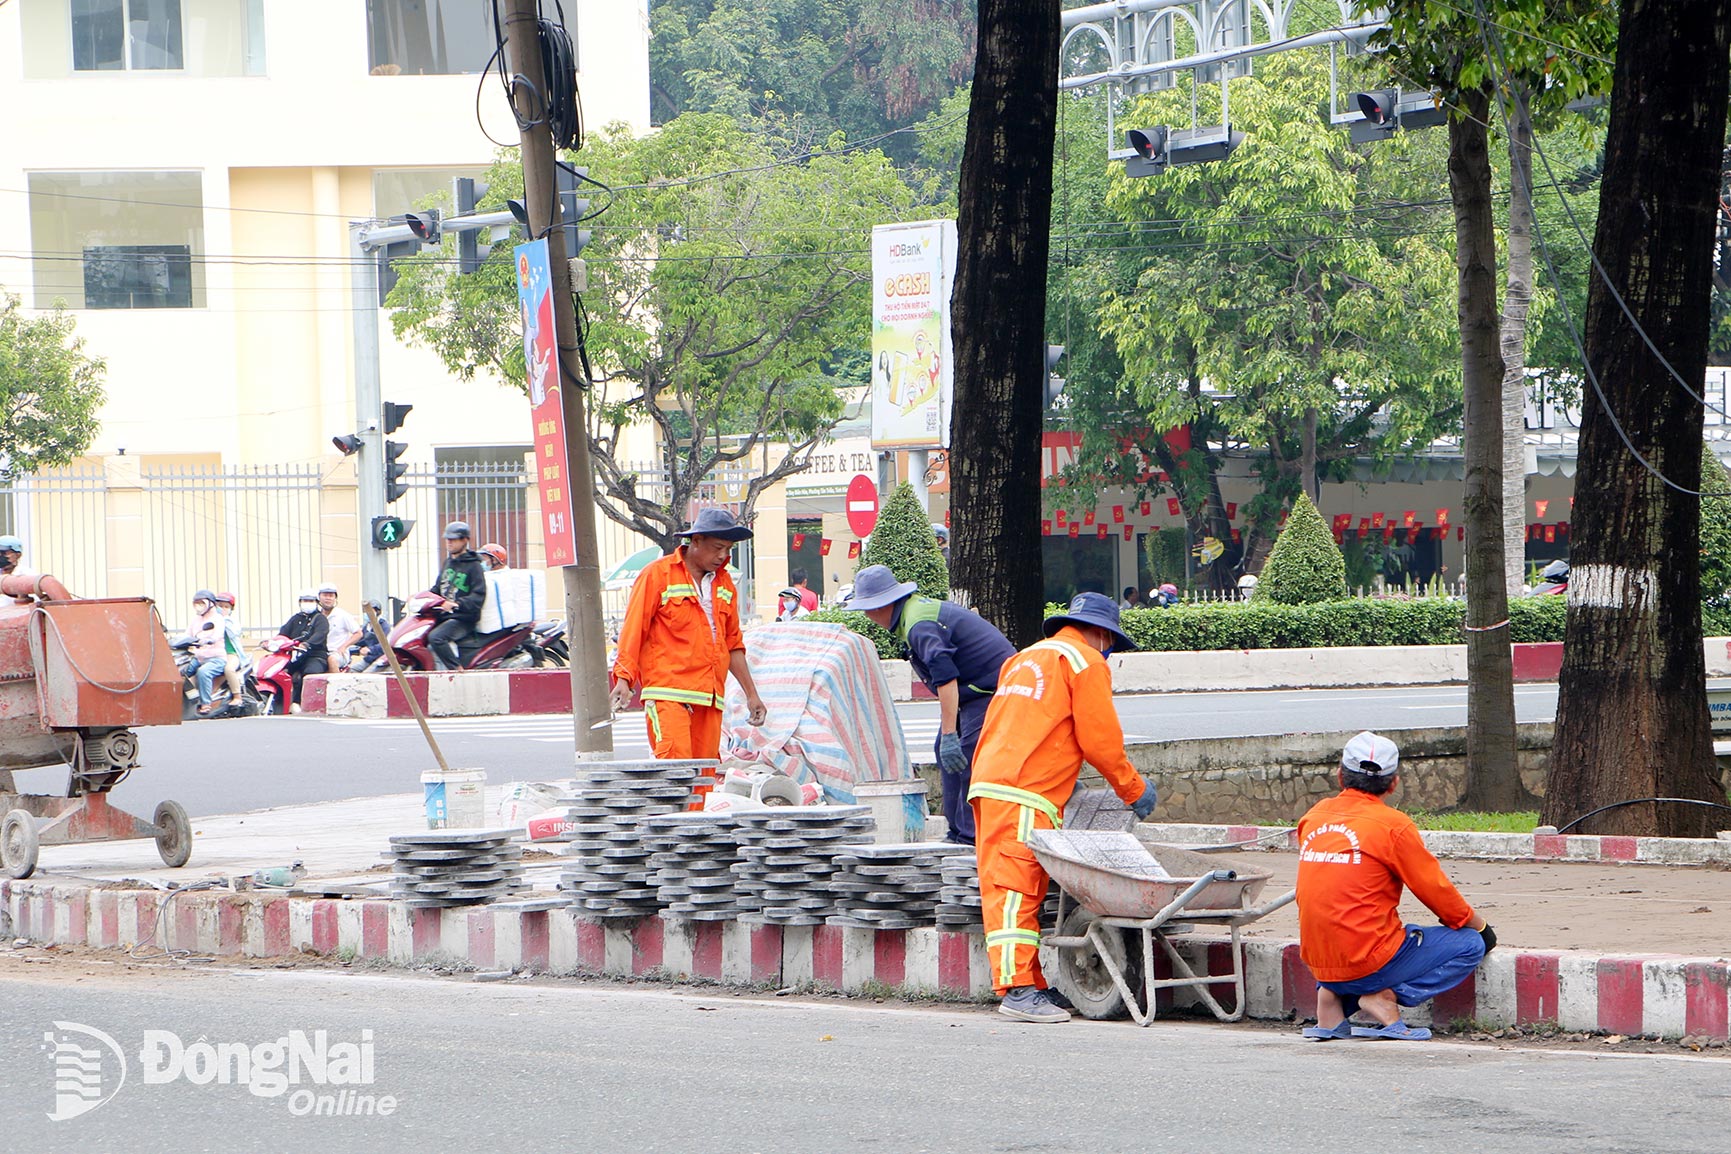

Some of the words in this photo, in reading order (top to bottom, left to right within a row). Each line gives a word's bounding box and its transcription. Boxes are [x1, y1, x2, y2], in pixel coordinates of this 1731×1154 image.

[889, 243, 921, 257] HDBank
[885, 272, 930, 297] eCASH
[839, 453, 847, 472] &
[851, 453, 873, 472] TEA
[549, 512, 564, 535] 09-11
[1307, 831, 1317, 841] TY
